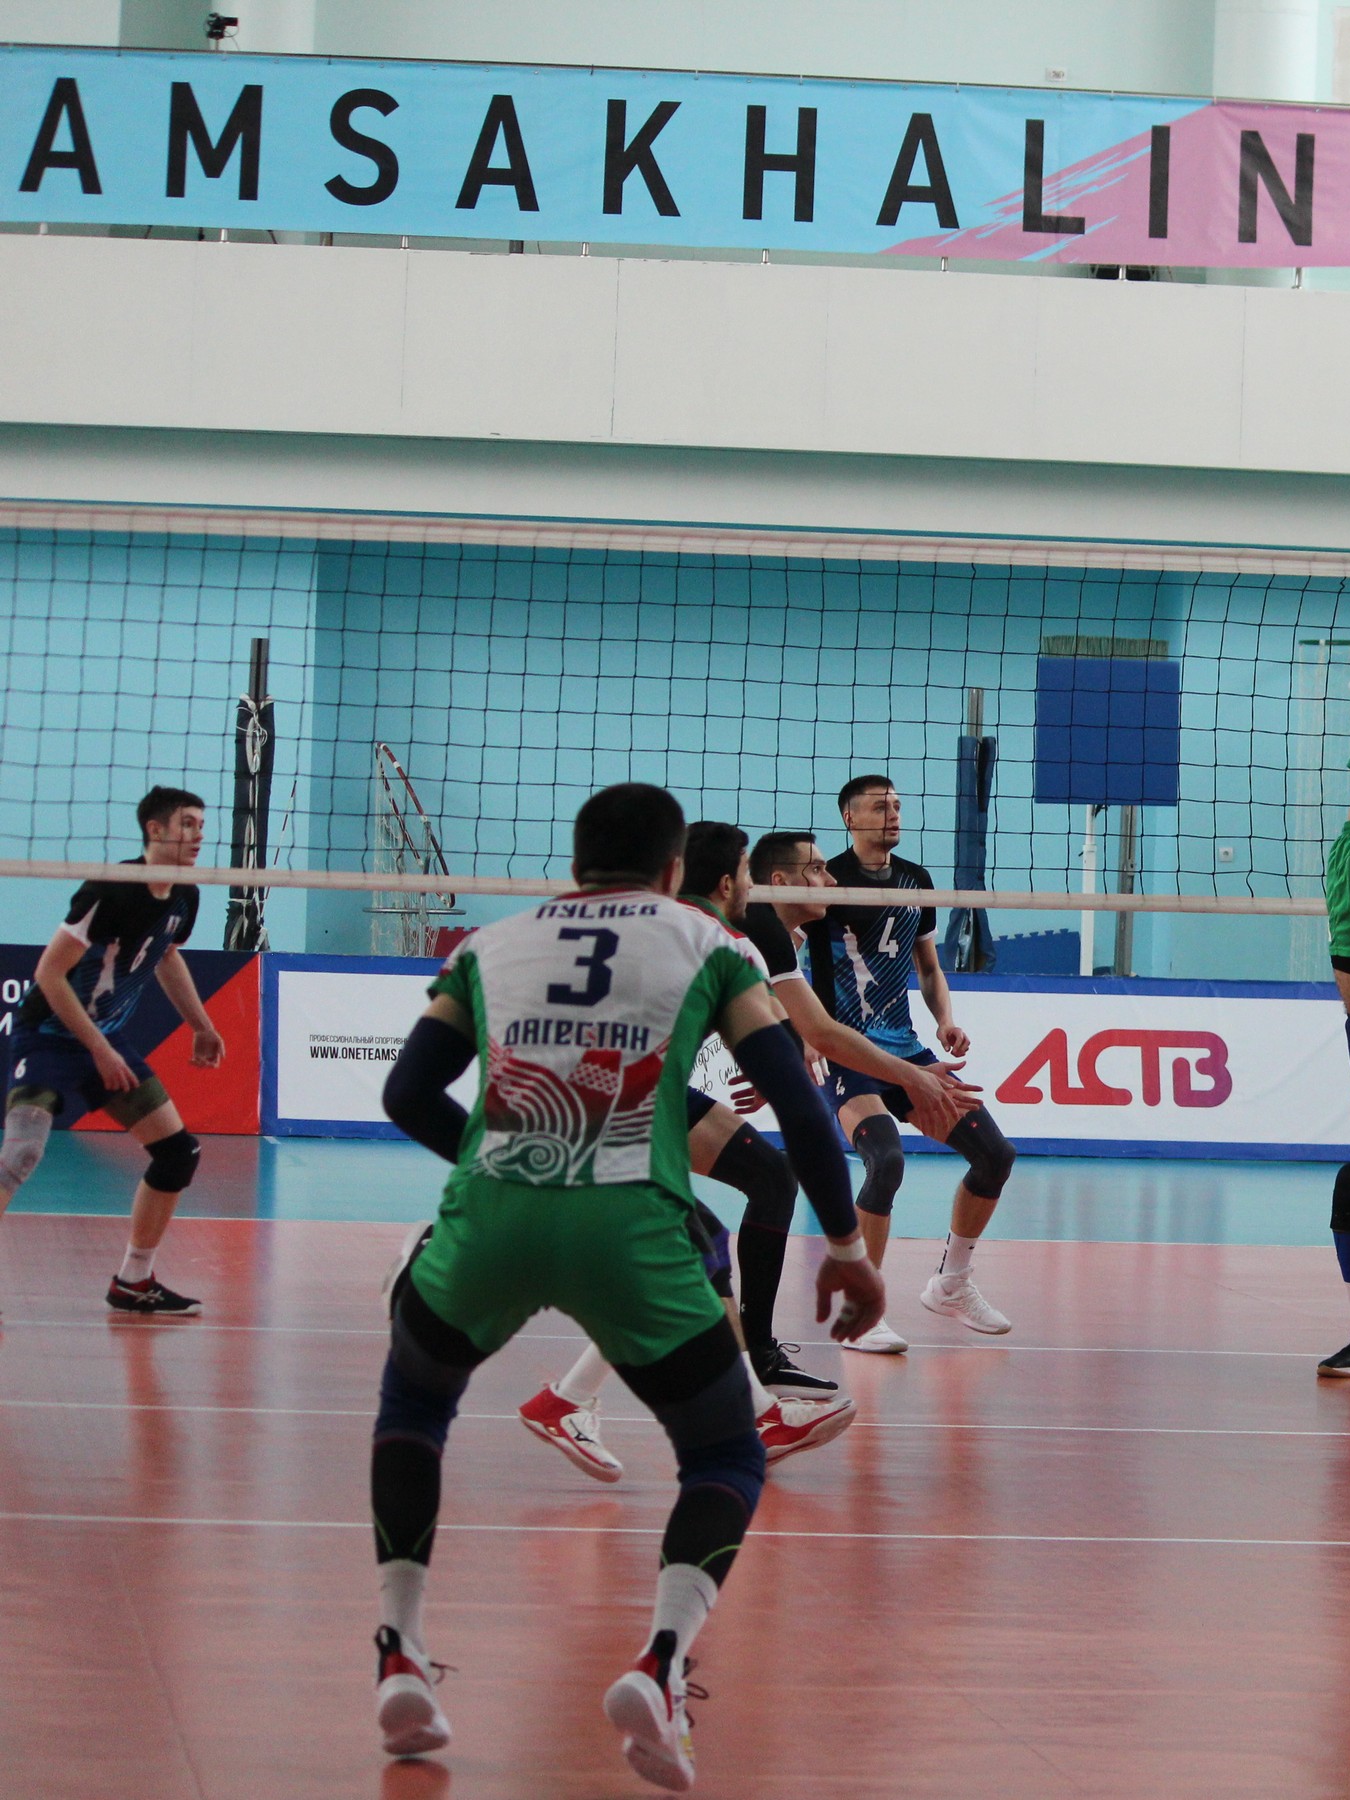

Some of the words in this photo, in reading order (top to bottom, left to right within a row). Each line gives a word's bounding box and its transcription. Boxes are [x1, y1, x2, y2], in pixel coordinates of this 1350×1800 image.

[19, 77, 1316, 247] AMSAKHALIN
[129, 936, 154, 973] 6
[878, 916, 899, 959] 4
[547, 927, 619, 1006] 3
[309, 1034, 374, 1045] ПРОФЕССИОНАЛЬНЫЙ
[503, 1018, 650, 1051] ДАГЕСТАН
[14, 1058, 27, 1079] 6
[835, 1076, 846, 1096] 4
